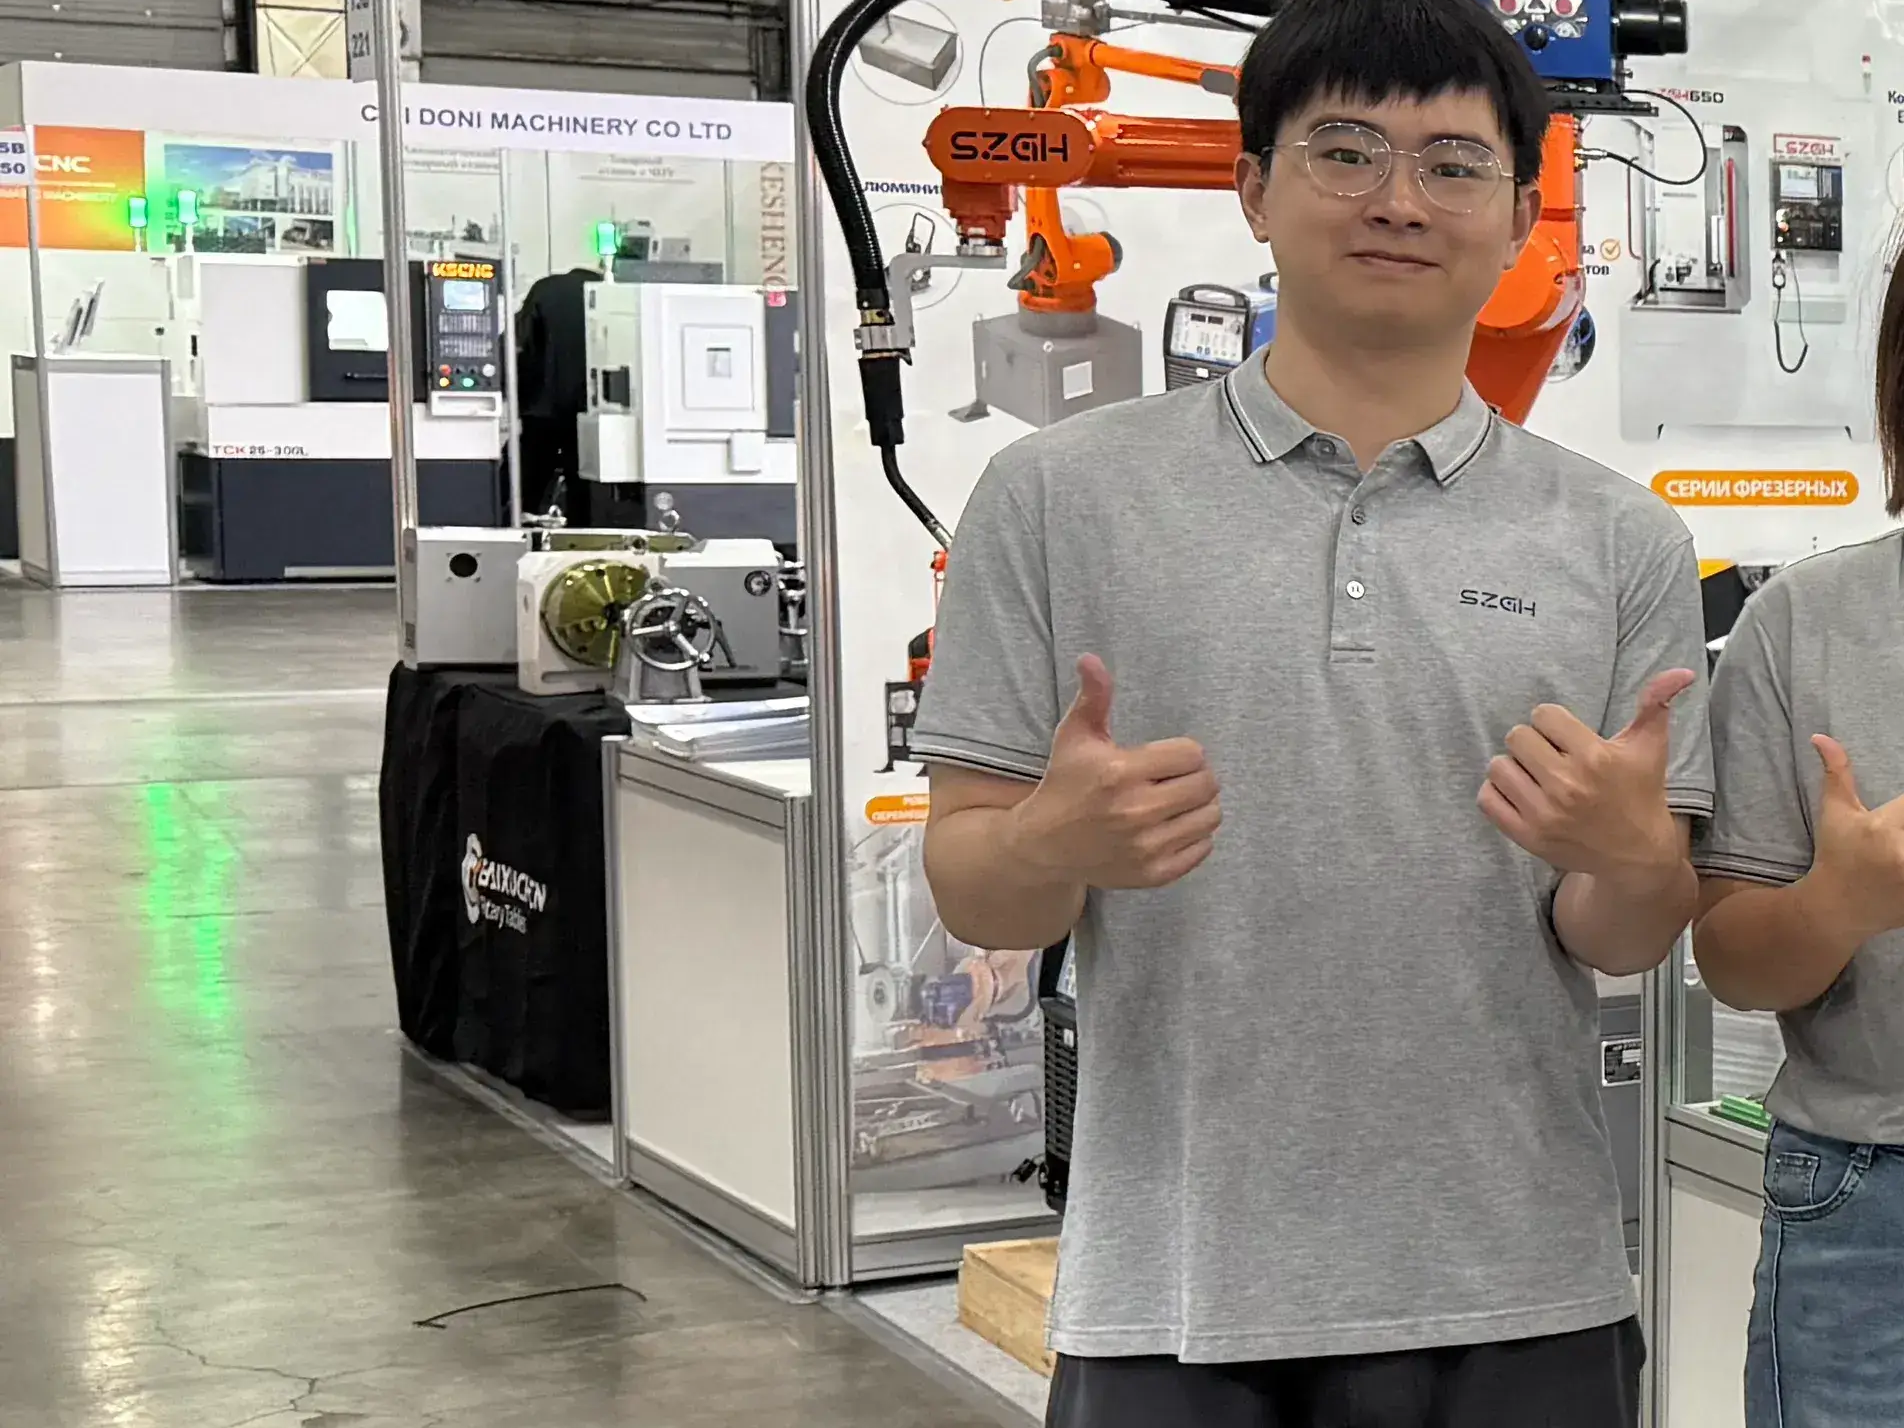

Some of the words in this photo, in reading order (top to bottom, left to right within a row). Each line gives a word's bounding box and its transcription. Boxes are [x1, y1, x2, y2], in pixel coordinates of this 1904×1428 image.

[419, 106, 482, 129] DONI
[490, 112, 639, 137] MACHINERY
[646, 120, 681, 140] CO
[689, 121, 733, 141] LTD
[0, 141, 26, 154] 5B
[950, 131, 1069, 164] SZGH
[34, 154, 92, 173] CNC
[1665, 478, 1731, 499] СЕРИИ
[1733, 477, 1849, 500] ФРЕЗЕРНЫХ
[1459, 588, 1538, 618] SZGH
